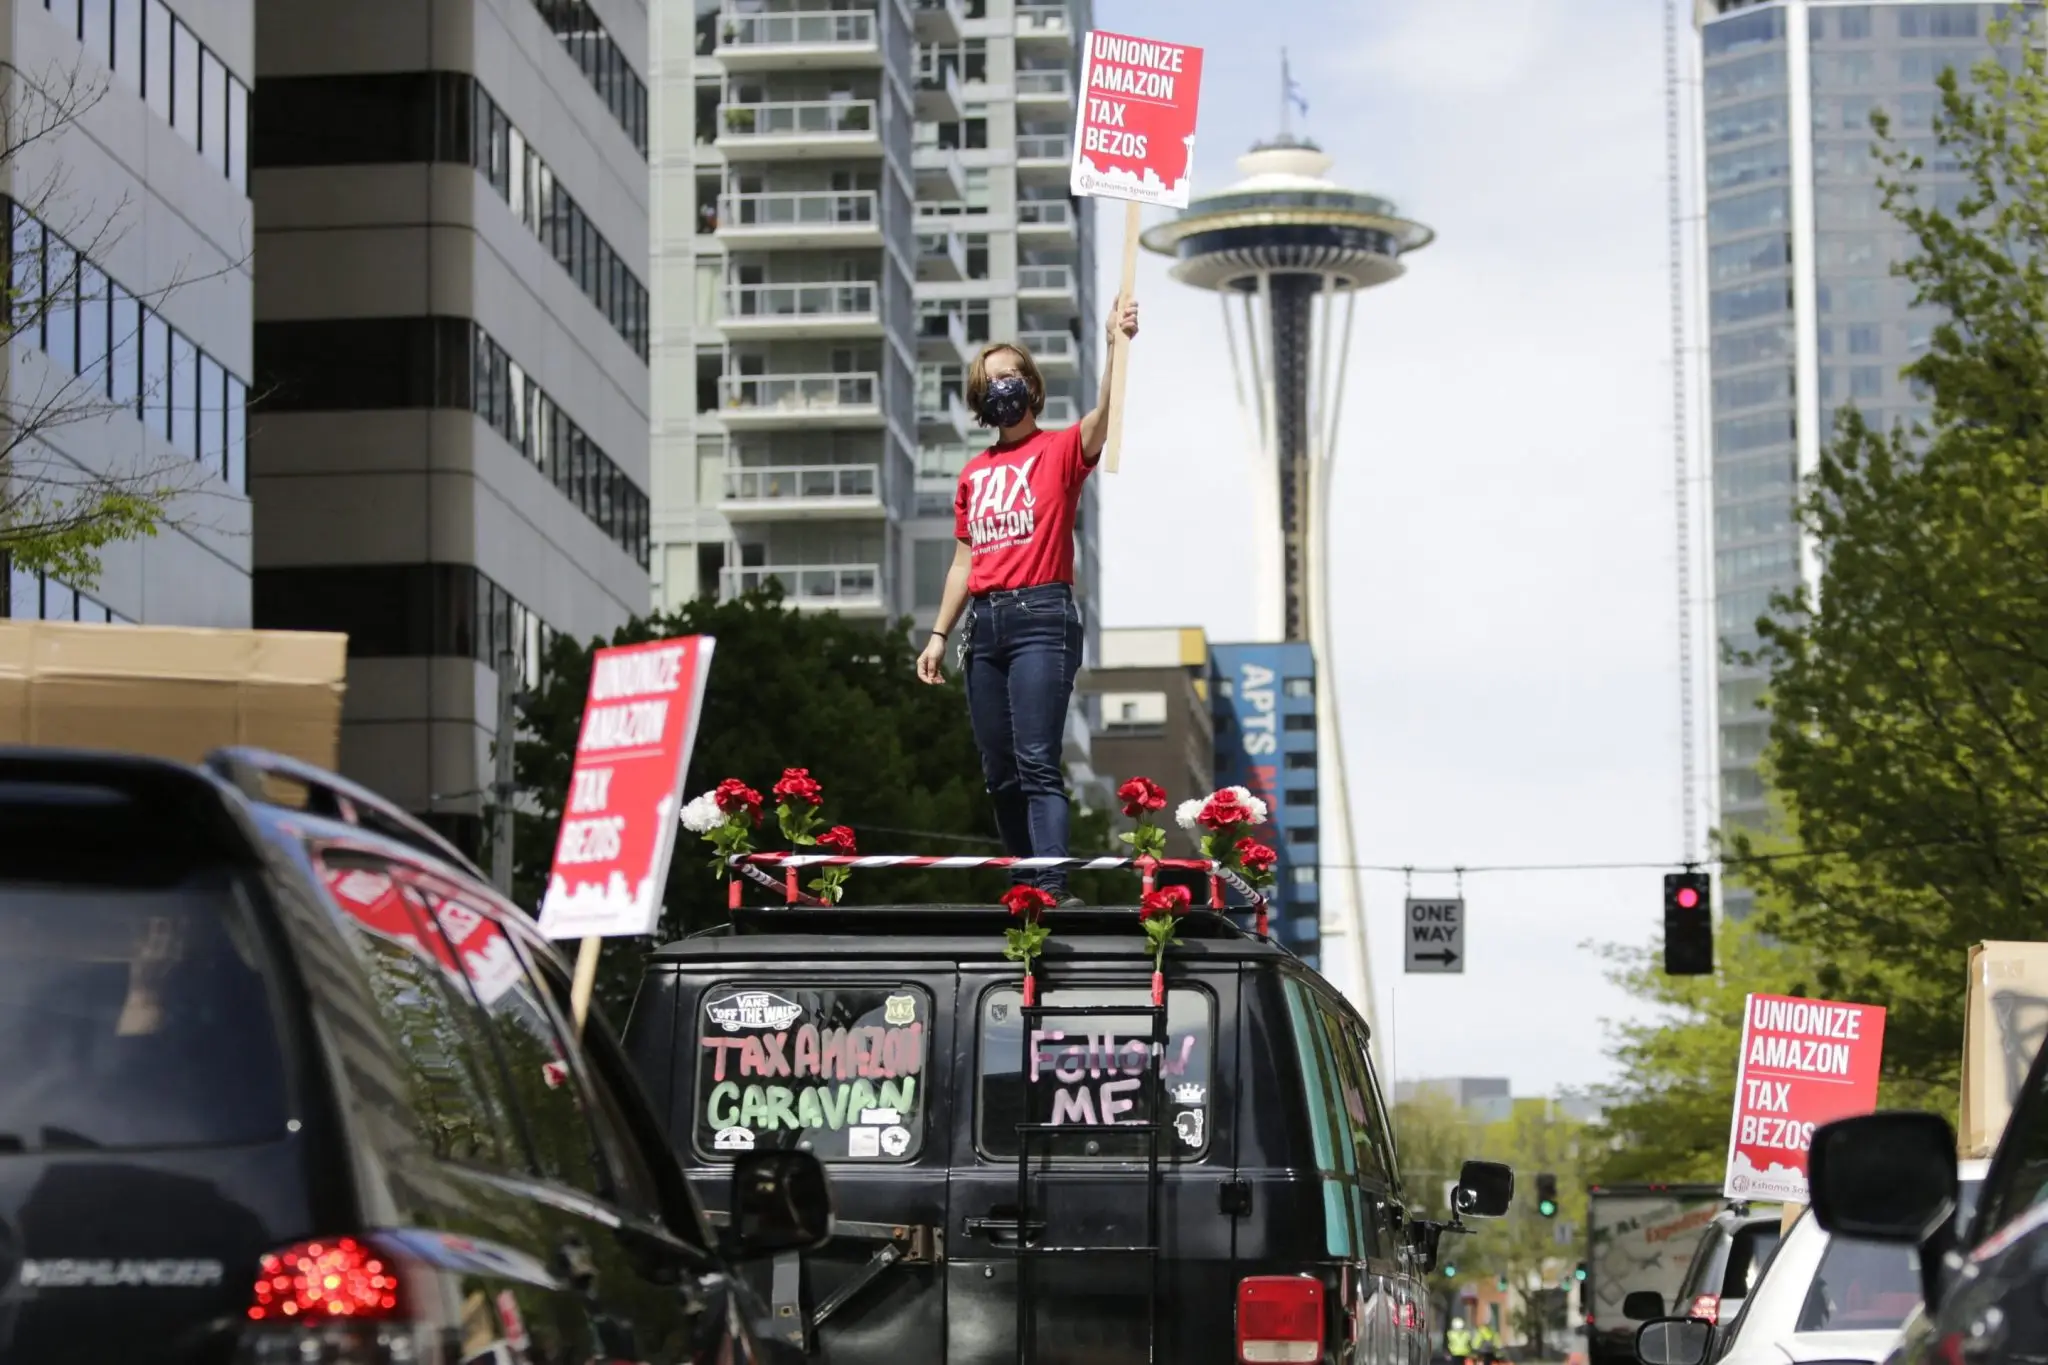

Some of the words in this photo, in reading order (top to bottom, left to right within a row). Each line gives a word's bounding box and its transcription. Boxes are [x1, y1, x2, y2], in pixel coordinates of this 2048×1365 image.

[1094, 35, 1184, 73] UNIONIZE
[1091, 64, 1174, 100] AMAZON
[1089, 98, 1126, 127] TAX
[1085, 127, 1148, 159] BEZOS
[968, 456, 1036, 522] TAX
[580, 699, 670, 752] AMAZON
[1240, 663, 1277, 757] APTS
[571, 767, 614, 814] TAX
[557, 815, 625, 865] BEZOS
[1412, 905, 1457, 922] ONE
[1412, 926, 1458, 942] WAY
[736, 994, 769, 1008] VANS
[739, 1007, 763, 1023] THE
[1754, 998, 1862, 1041] UNIONIZE
[701, 1031, 792, 1082] TAX
[794, 1022, 923, 1081] AMAZON
[1749, 1035, 1849, 1075] AMAZON
[707, 1076, 916, 1131] CARAVAN
[1052, 1078, 1150, 1125] ME
[1746, 1079, 1791, 1113] TAX
[1740, 1116, 1815, 1151] BEZOS
[1751, 1180, 1790, 1193] Kshama
